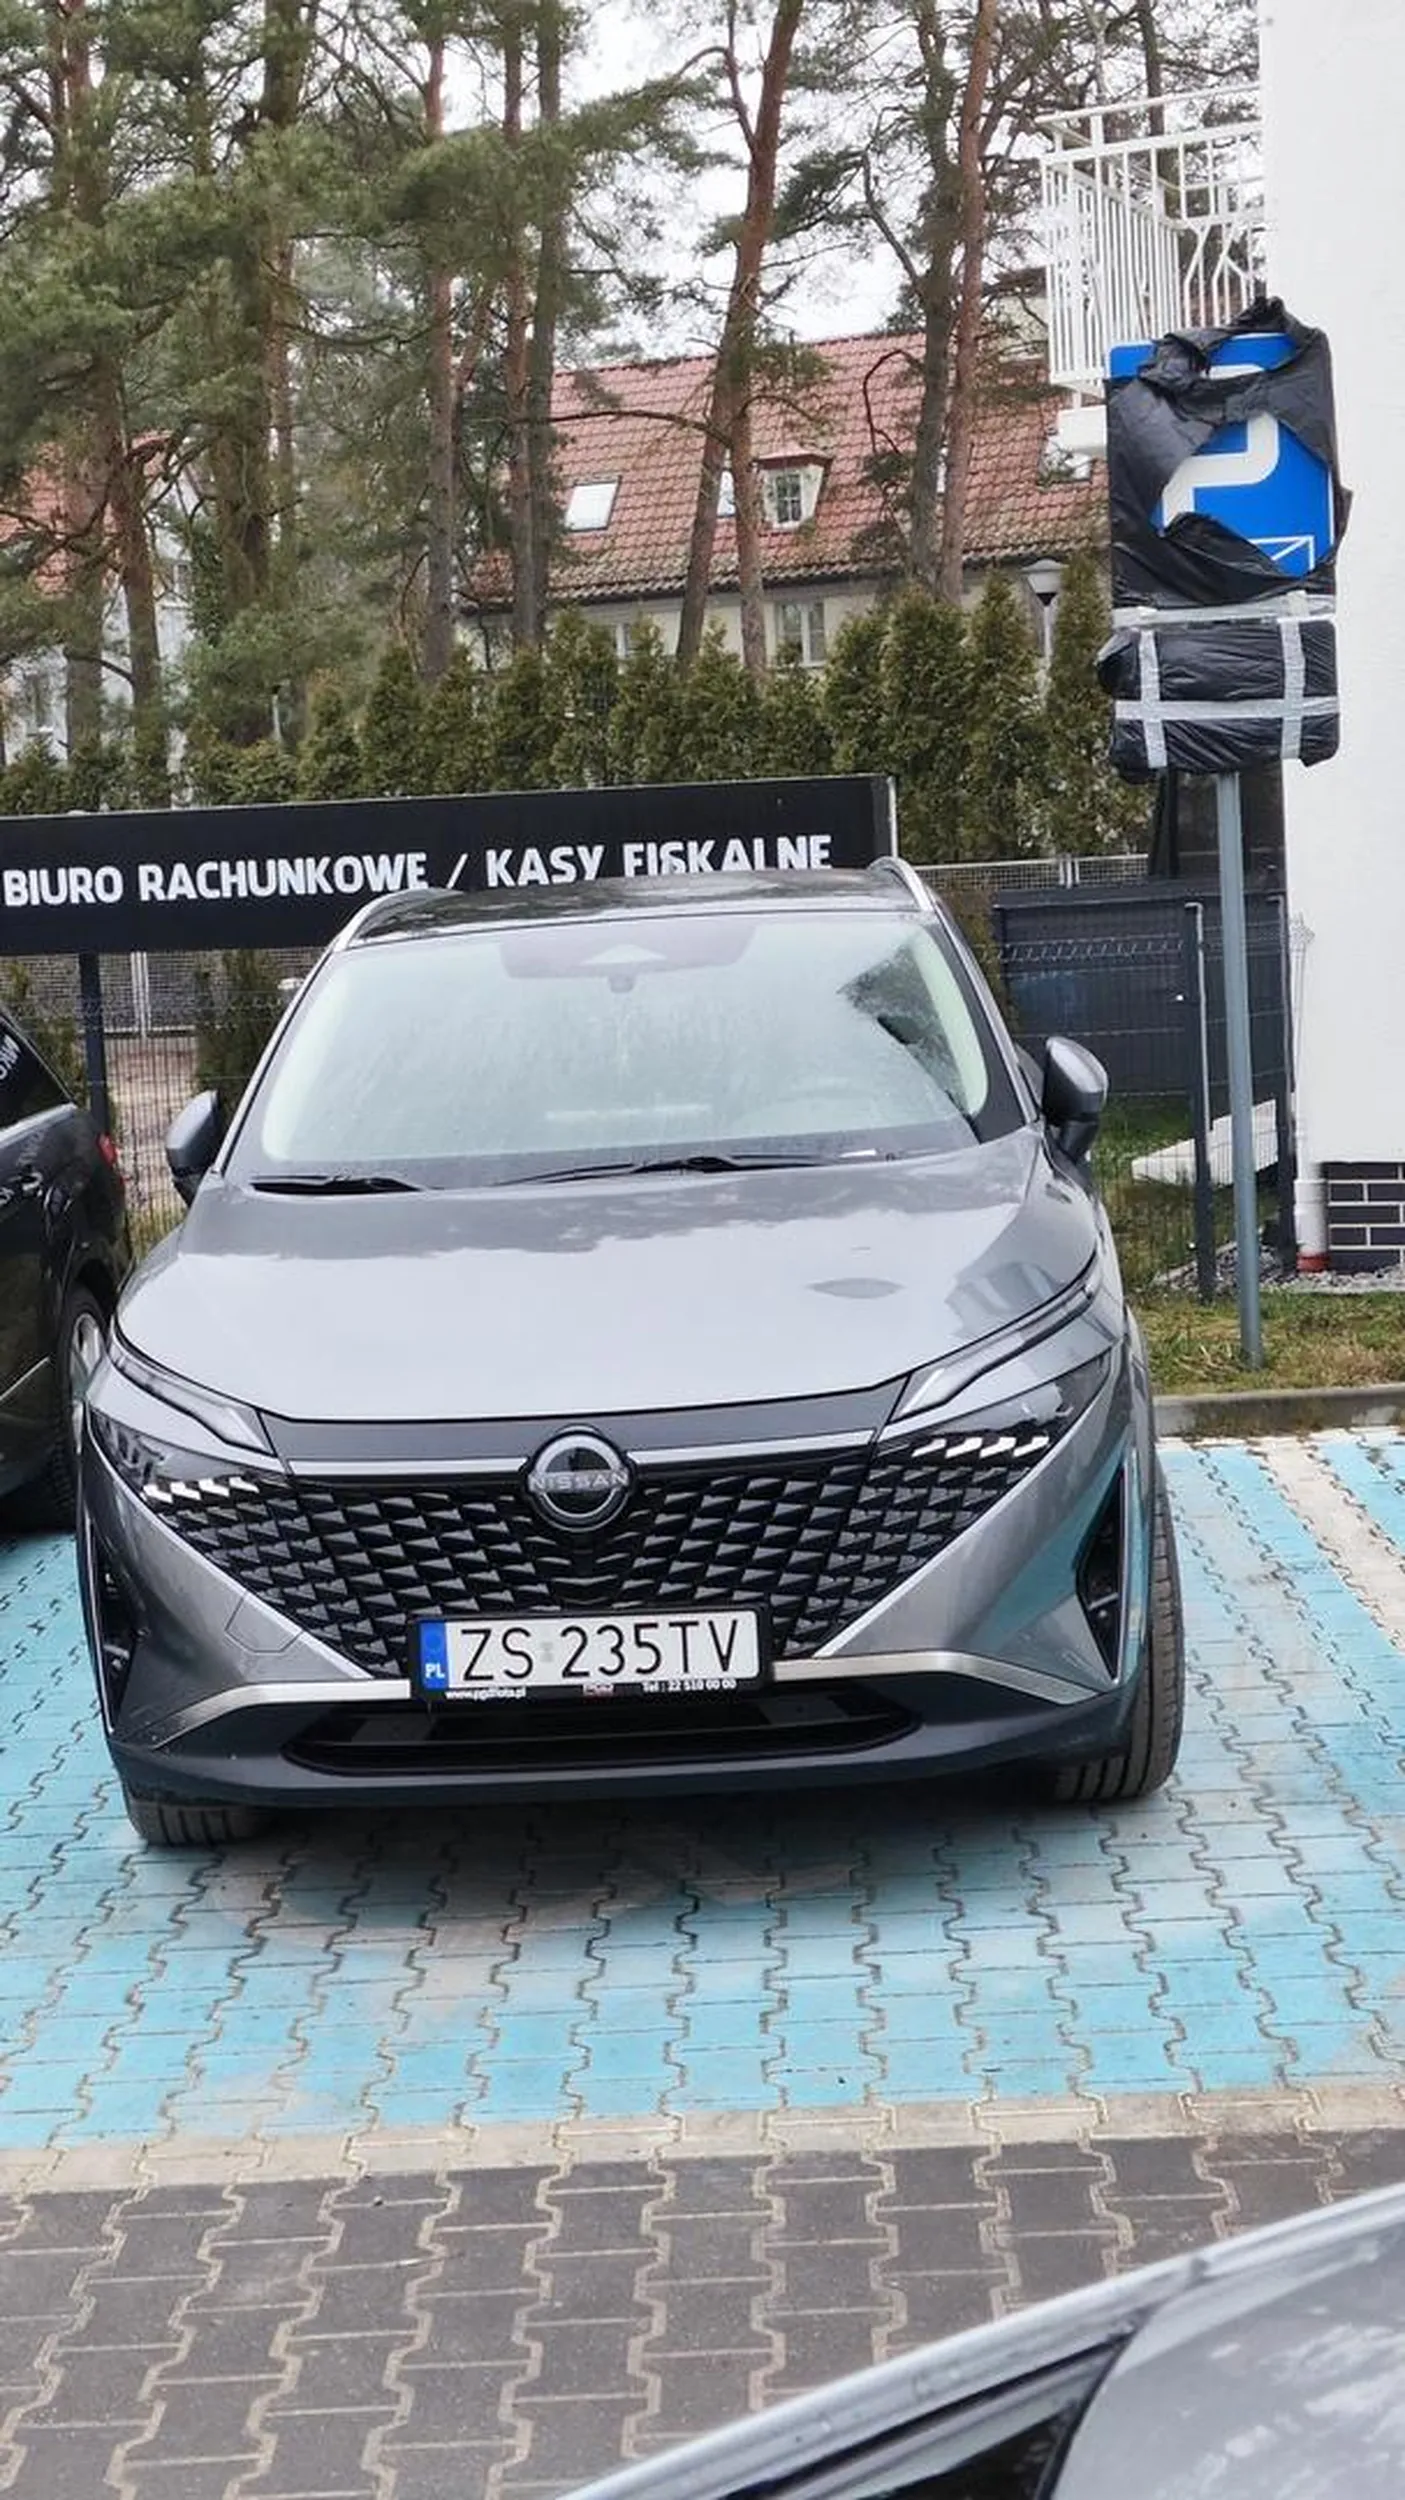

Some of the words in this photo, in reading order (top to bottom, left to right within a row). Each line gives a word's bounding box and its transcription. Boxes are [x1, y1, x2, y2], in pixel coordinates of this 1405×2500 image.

[3, 865, 123, 906] BIURO
[138, 852, 427, 901] RACHUNKOWE
[485, 846, 604, 888] KASY
[527, 1469, 630, 1492] NISSAN
[425, 1662, 446, 1679] PL
[461, 1626, 534, 1682] ZS
[560, 1618, 739, 1679] 235TV
